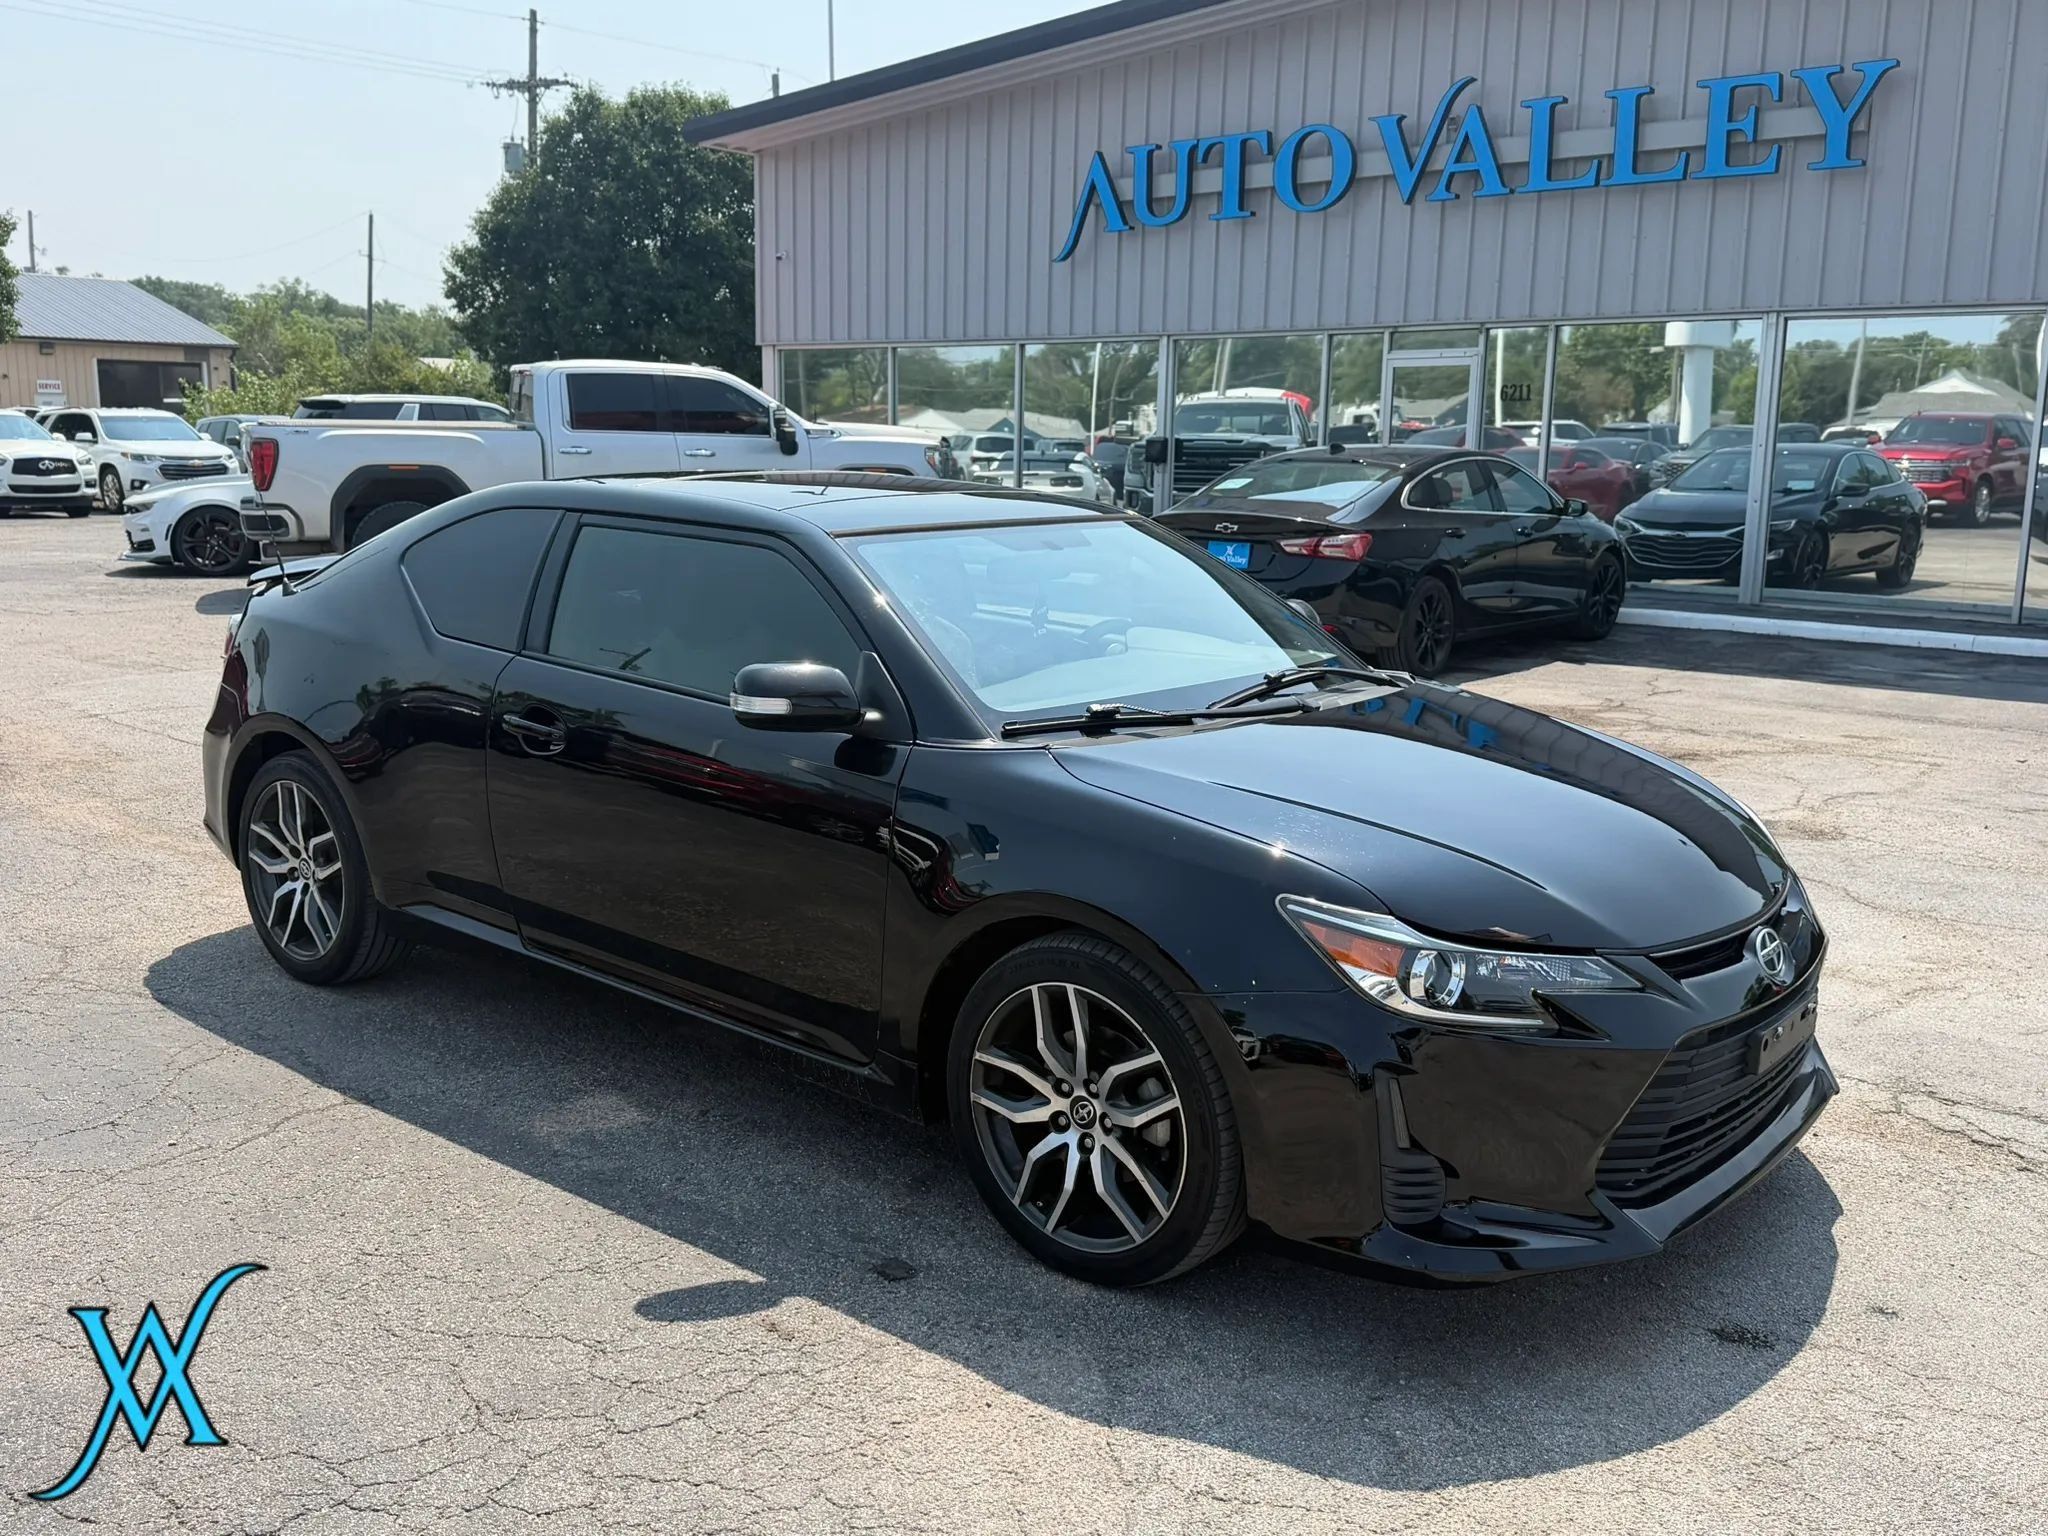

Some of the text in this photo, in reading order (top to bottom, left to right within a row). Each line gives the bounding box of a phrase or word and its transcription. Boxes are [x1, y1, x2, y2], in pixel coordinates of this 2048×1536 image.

[1053, 57, 1901, 263] AUTO VALLEY
[1500, 383, 1532, 401] 6211
